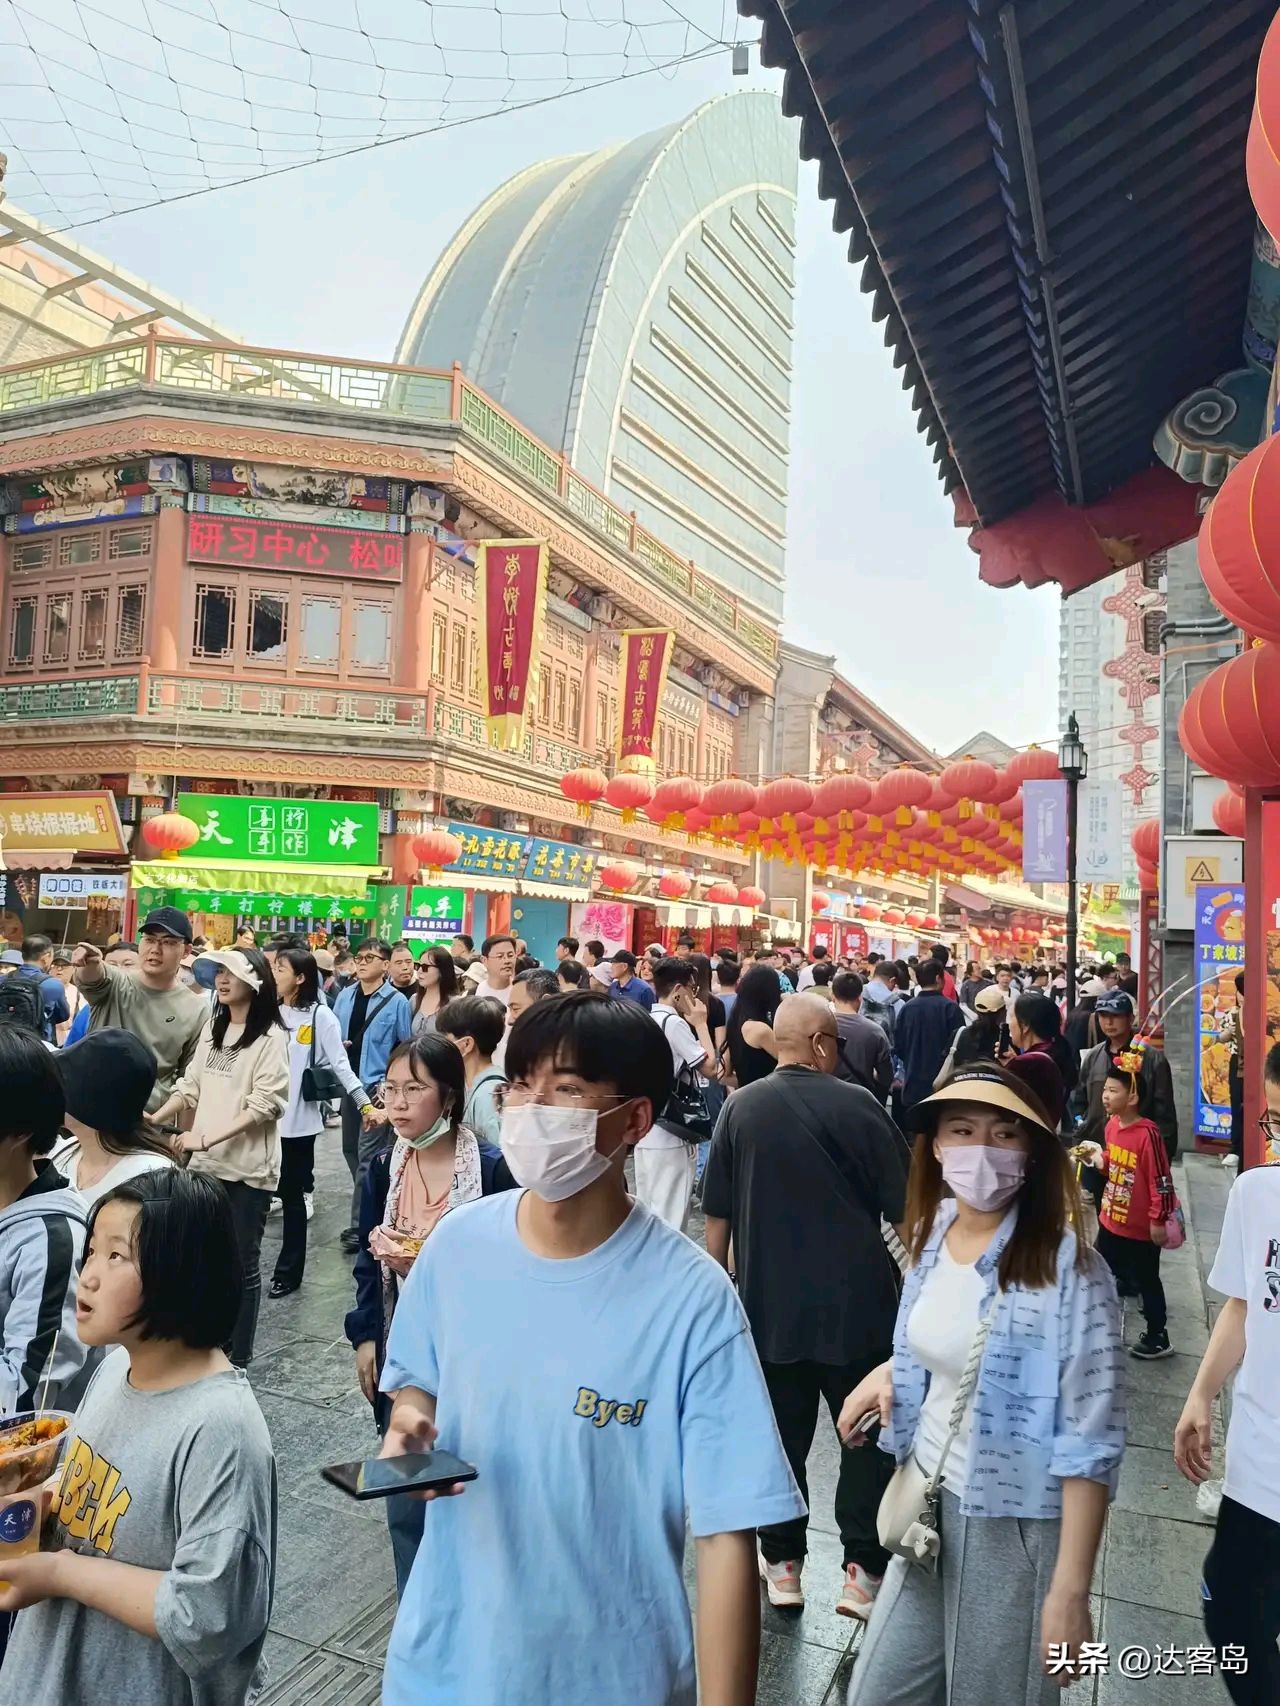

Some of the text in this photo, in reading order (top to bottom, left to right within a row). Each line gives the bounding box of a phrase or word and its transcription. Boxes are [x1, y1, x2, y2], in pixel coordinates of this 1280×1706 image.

[190, 521, 330, 566] 研习中心
[199, 810, 234, 845] 天
[328, 816, 364, 851] 津
[209, 898, 345, 917] 手打柠檬茶
[573, 1386, 648, 1428] Bye!
